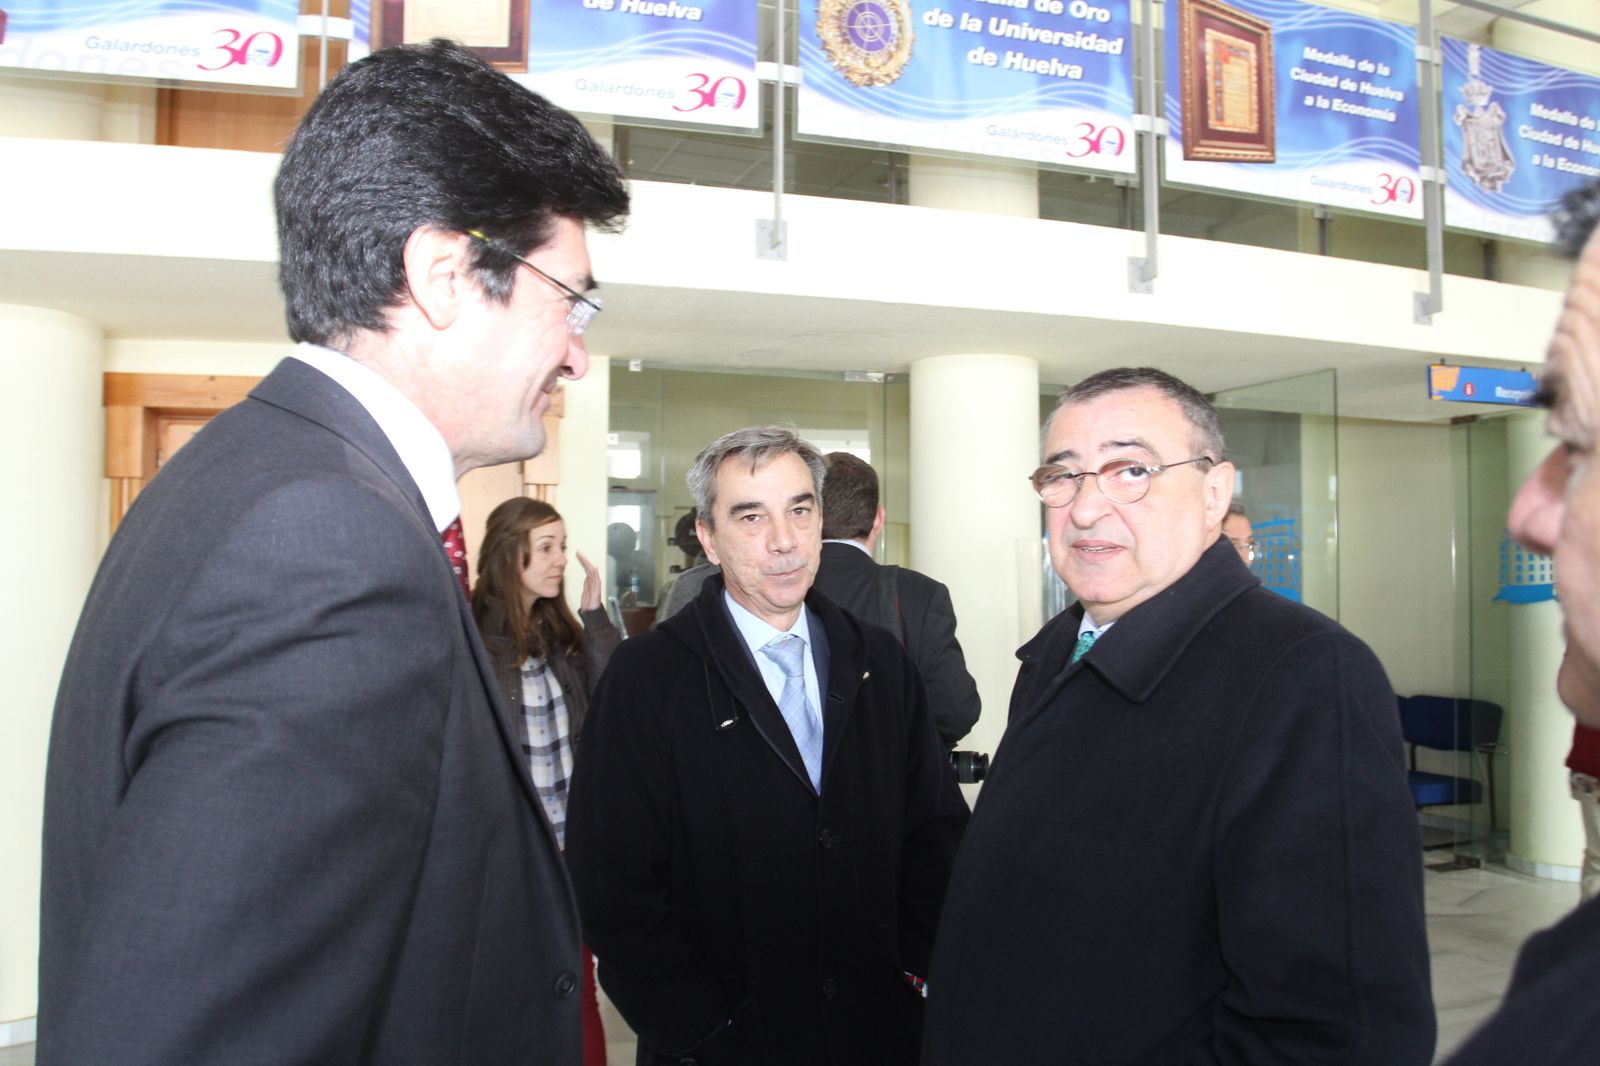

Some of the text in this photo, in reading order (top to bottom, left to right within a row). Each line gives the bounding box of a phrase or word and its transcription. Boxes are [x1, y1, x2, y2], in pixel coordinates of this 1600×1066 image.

[620, 0, 703, 21] Huelva
[1034, 0, 1064, 15] de
[1069, 0, 1111, 23] Oro
[923, 8, 1124, 55] de la Universidad
[85, 28, 283, 71] Galardones 30
[967, 47, 1083, 80] de Huelva
[1303, 46, 1391, 76] Medalla de la
[575, 78, 675, 100] Galardones
[672, 73, 746, 112] 30
[1290, 67, 1404, 101] Ciudad de Huelva
[1304, 95, 1396, 122] a la Economía
[1530, 103, 1578, 126] Medalla
[1579, 116, 1596, 130] de
[987, 124, 1069, 146] Galardones
[1066, 122, 1125, 157] 30
[1518, 124, 1563, 146] Ciudad
[1563, 136, 1580, 150] de
[1531, 154, 1541, 165] a
[1542, 154, 1555, 168] la
[1310, 174, 1372, 195] Galardones
[1370, 173, 1414, 205] 30
